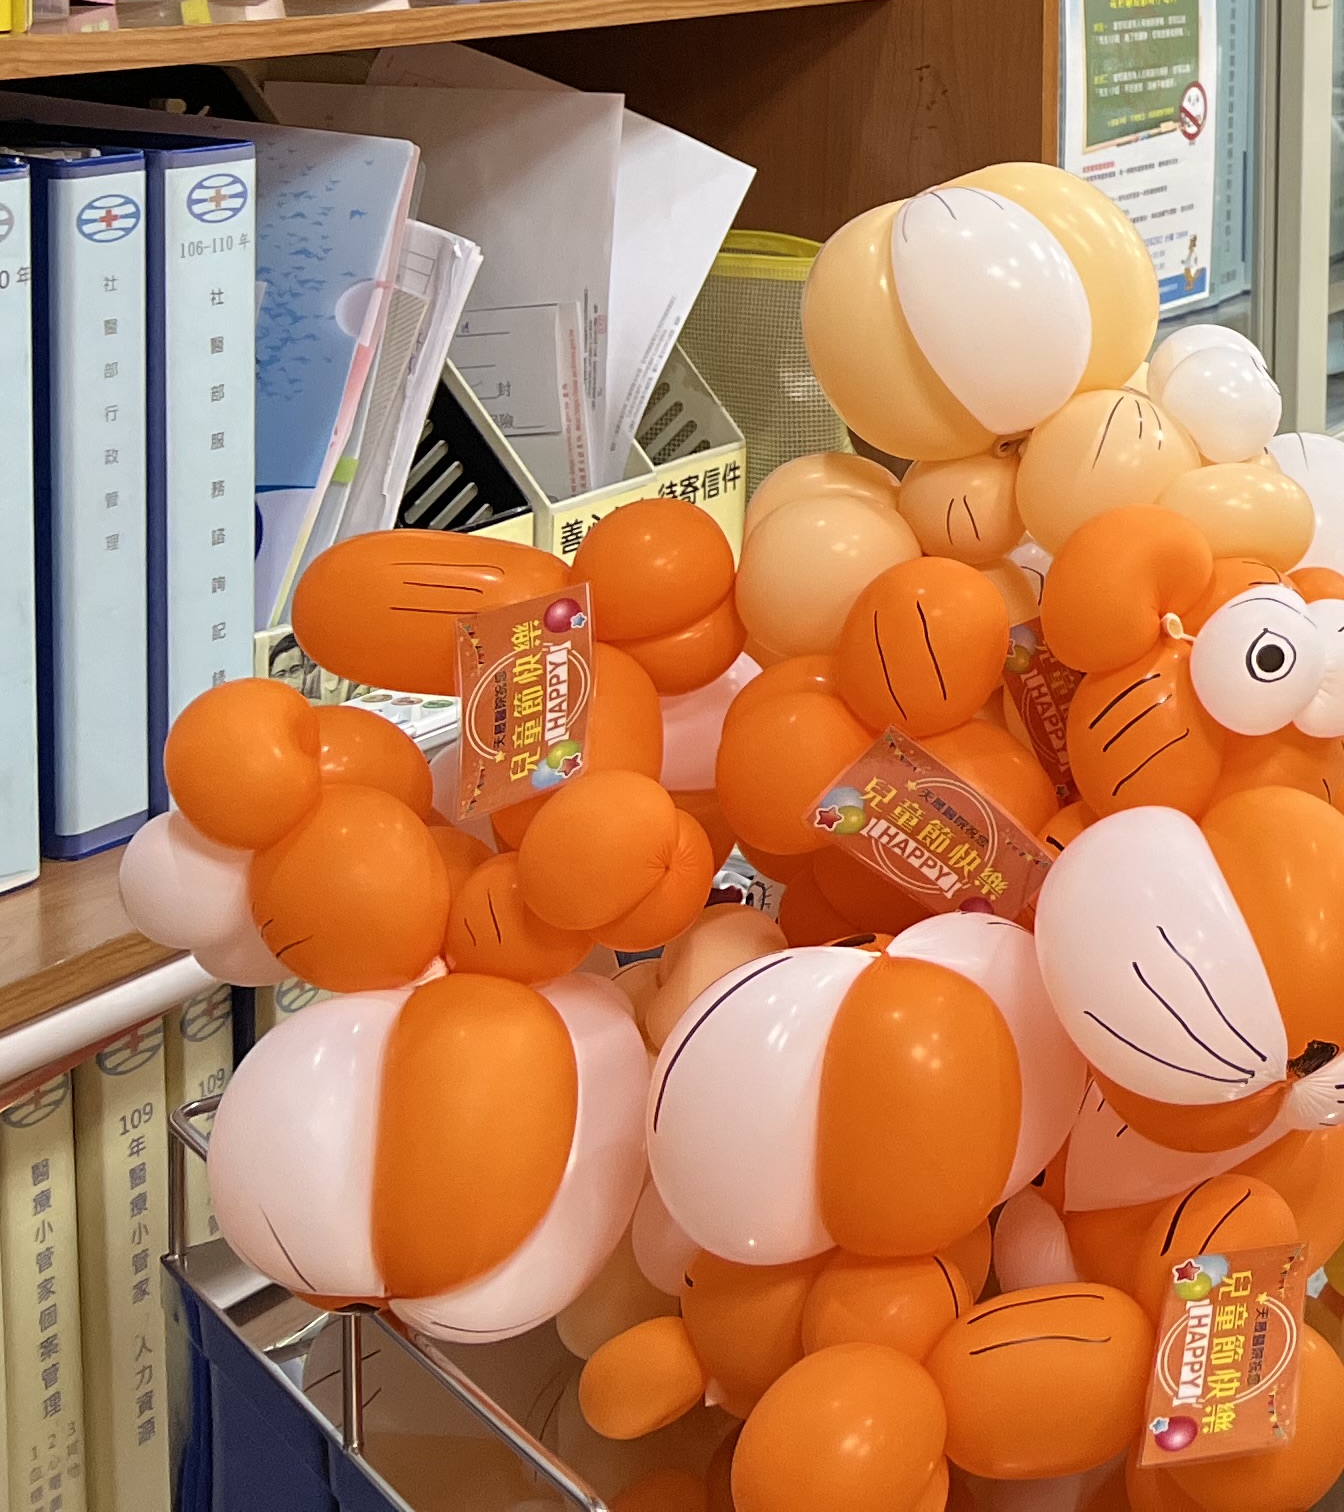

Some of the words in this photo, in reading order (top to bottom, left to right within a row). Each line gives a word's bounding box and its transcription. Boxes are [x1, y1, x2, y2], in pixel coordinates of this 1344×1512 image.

[178, 236, 233, 259] 106-110
[237, 233, 251, 251] 年
[103, 274, 120, 552] 社醫部行政管理
[510, 618, 543, 782] 兒童節快樂
[547, 661, 568, 731] HAPPY
[860, 776, 1009, 902] 兒童節快樂
[880, 821, 952, 888] HAPPY
[199, 1067, 226, 1097] 109
[31, 1158, 62, 1420] 醫療小管家個案管理
[134, 1334, 157, 1446] 人力資源
[1182, 1313, 1210, 1385] HAPPY
[1202, 1269, 1253, 1435] 兒童節快樂
